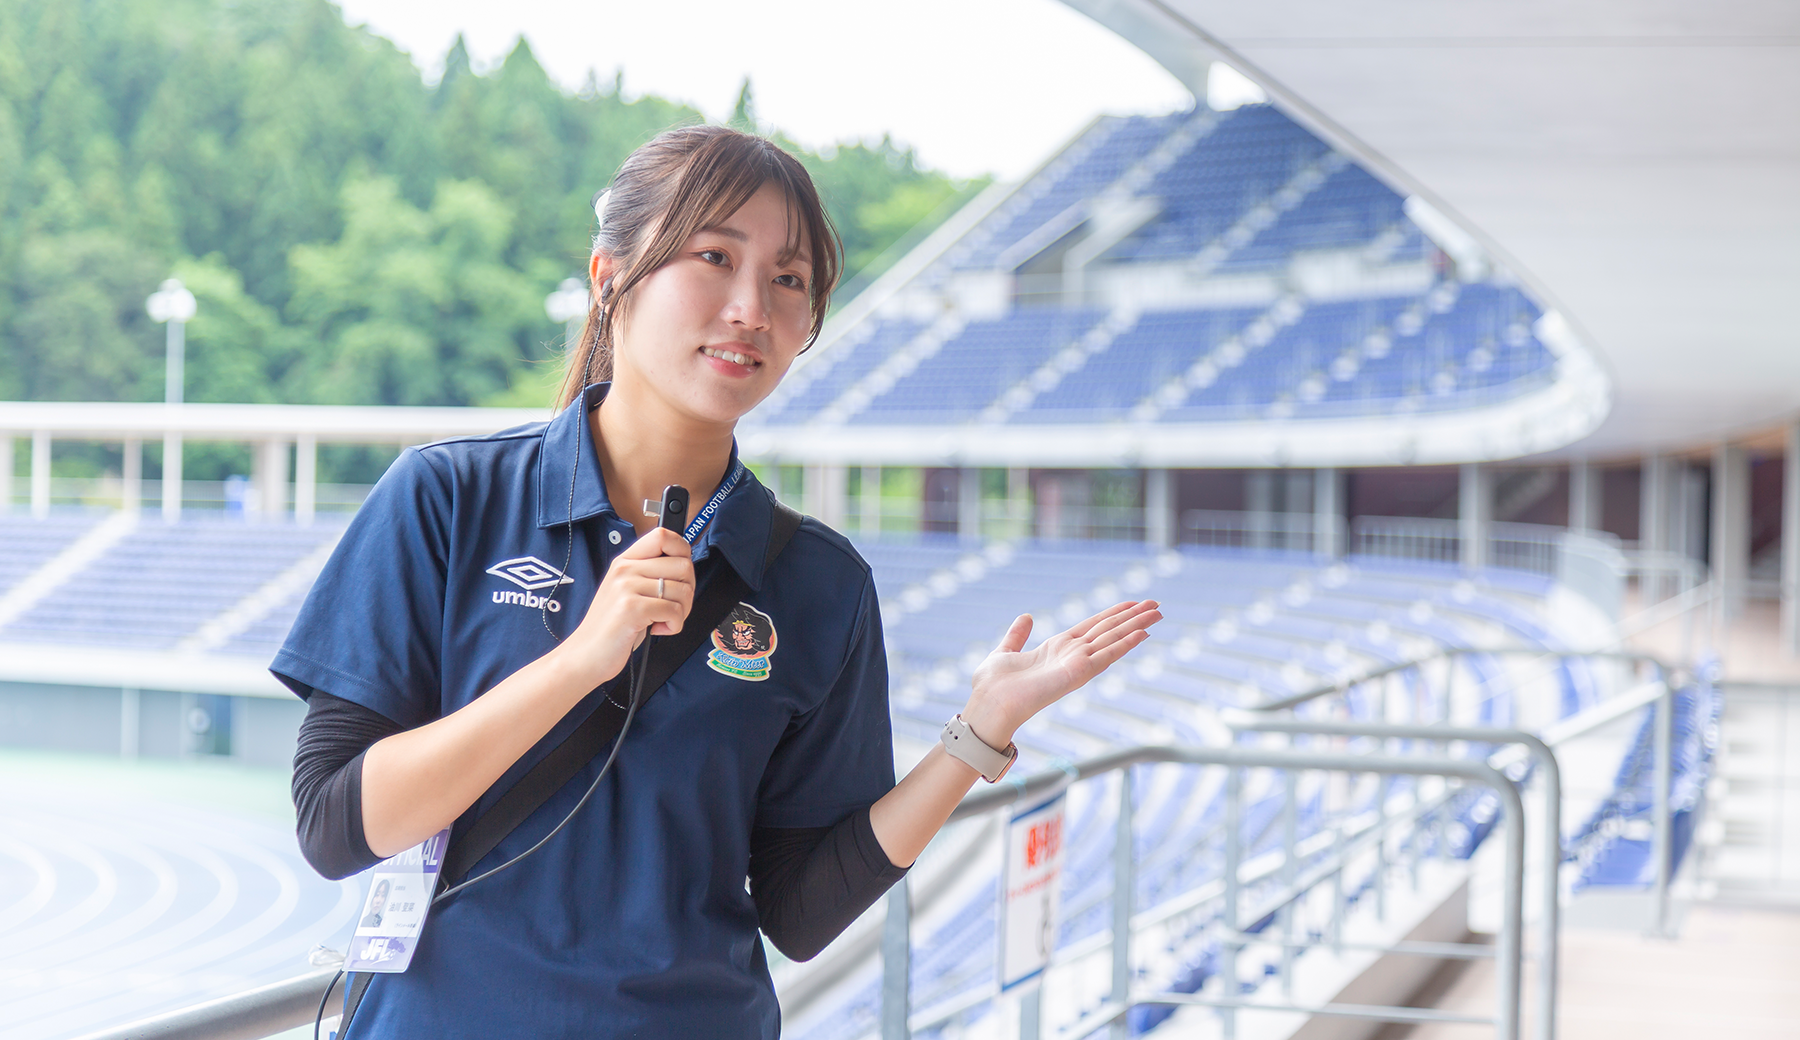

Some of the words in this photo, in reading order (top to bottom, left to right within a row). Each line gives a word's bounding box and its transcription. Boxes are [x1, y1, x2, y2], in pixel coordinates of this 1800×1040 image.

[682, 516, 706, 544] JAPAN
[701, 482, 734, 519] FOOTBALL
[492, 590, 561, 613] umbro
[360, 938, 393, 961] JFL
